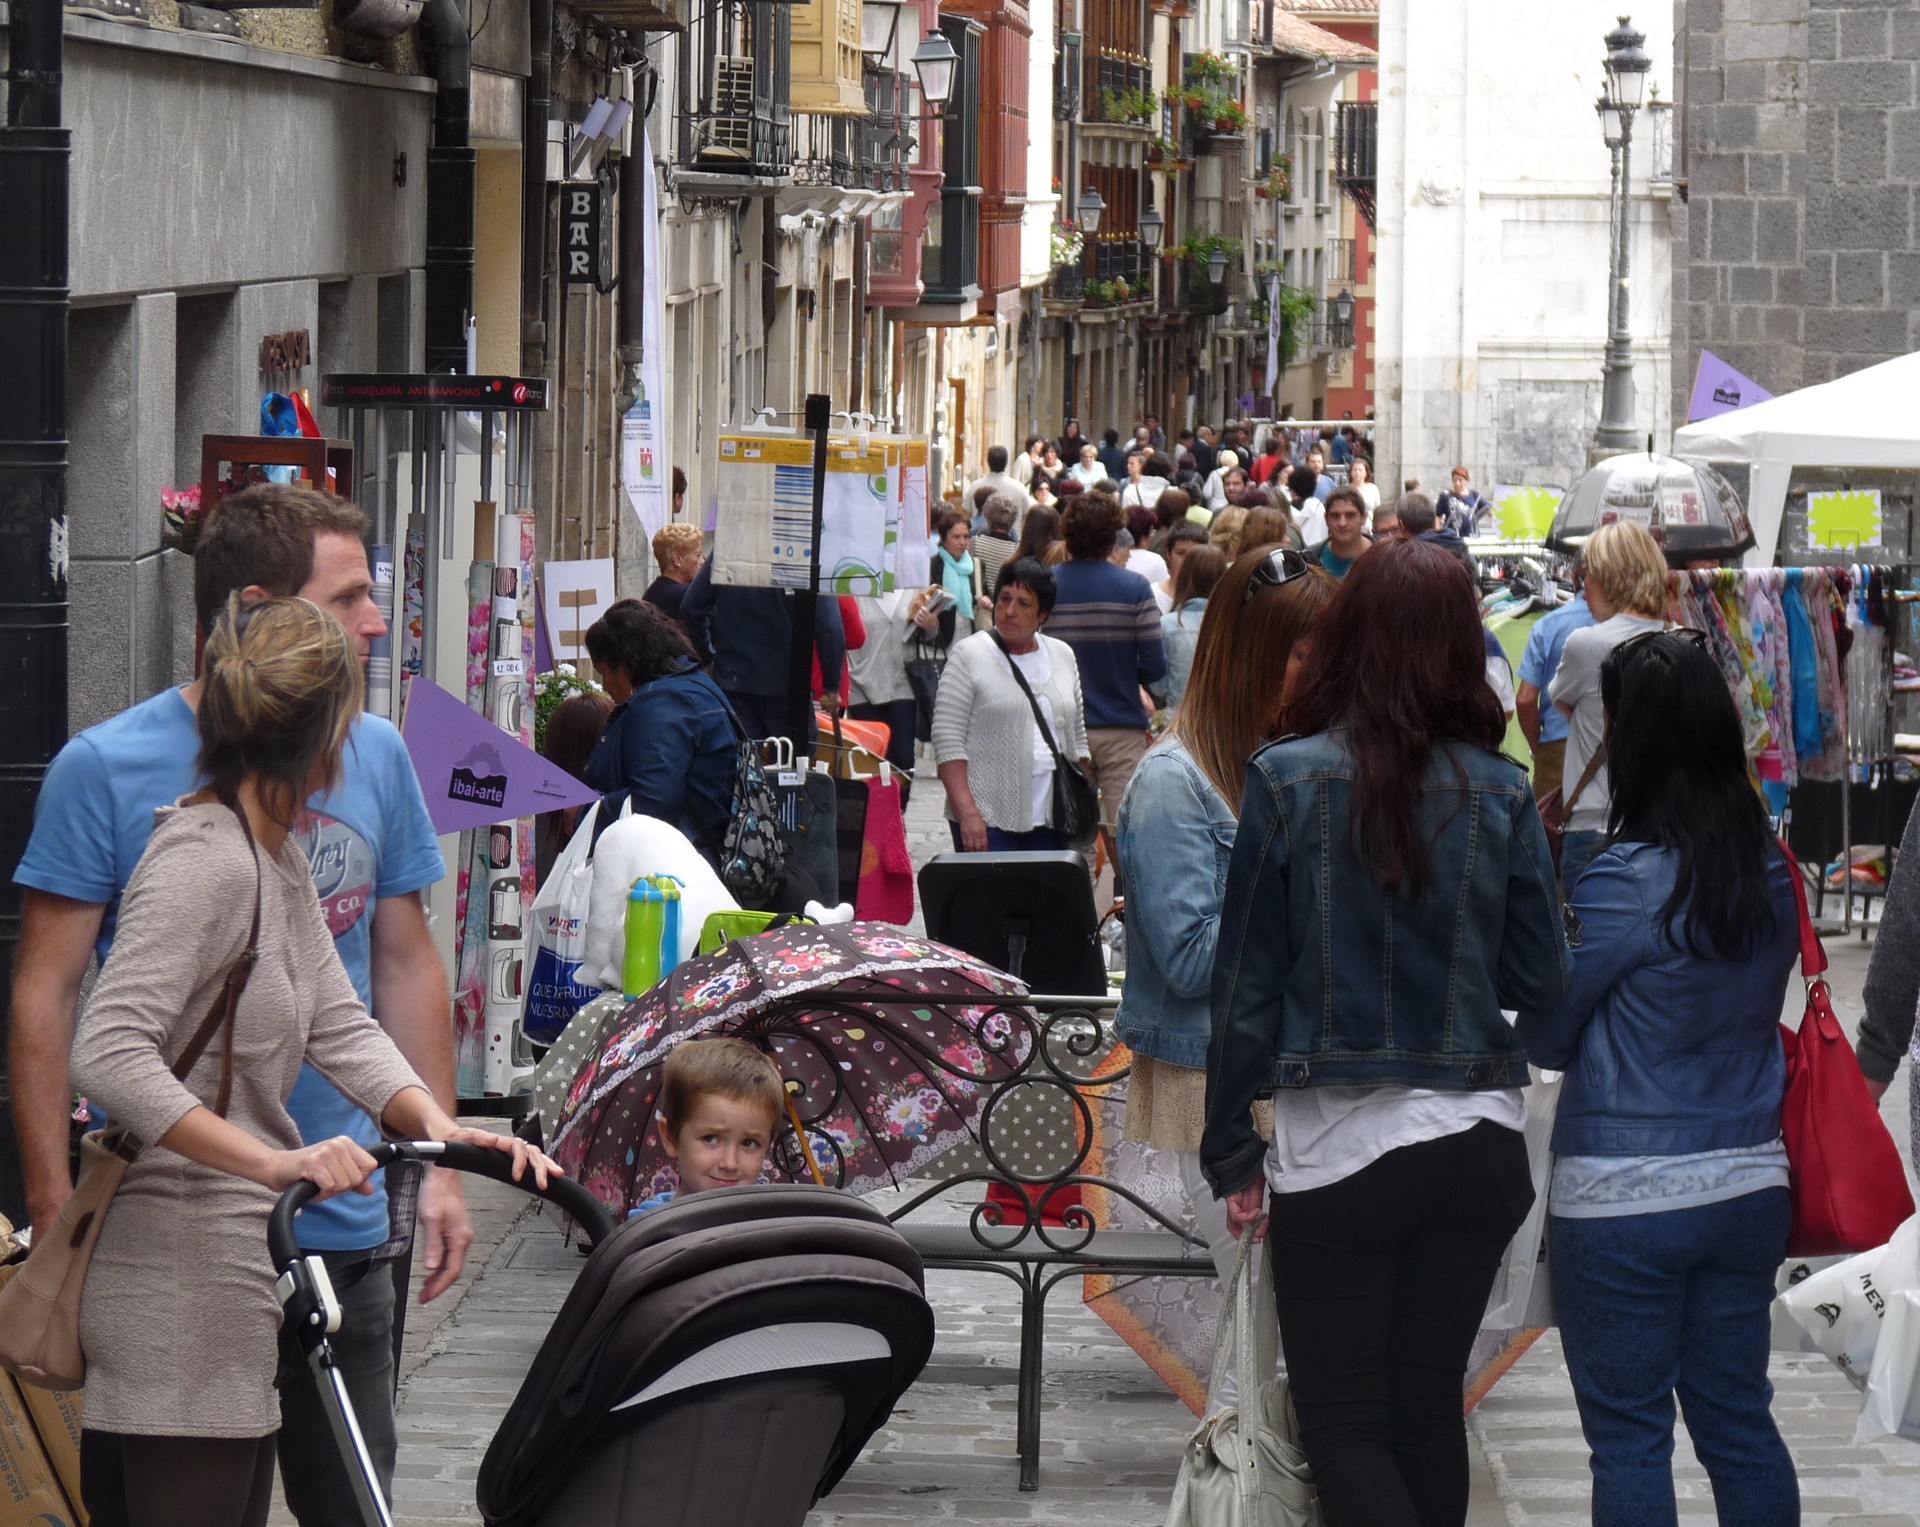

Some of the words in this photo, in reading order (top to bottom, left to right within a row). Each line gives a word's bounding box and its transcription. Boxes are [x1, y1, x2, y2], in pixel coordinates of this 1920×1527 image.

[569, 191, 591, 275] BAR
[408, 386, 481, 397] ANTIMANCHAS
[452, 778, 503, 802] ibai-arte
[532, 982, 552, 998] QUE
[58, 1403, 81, 1452] ENABLE
